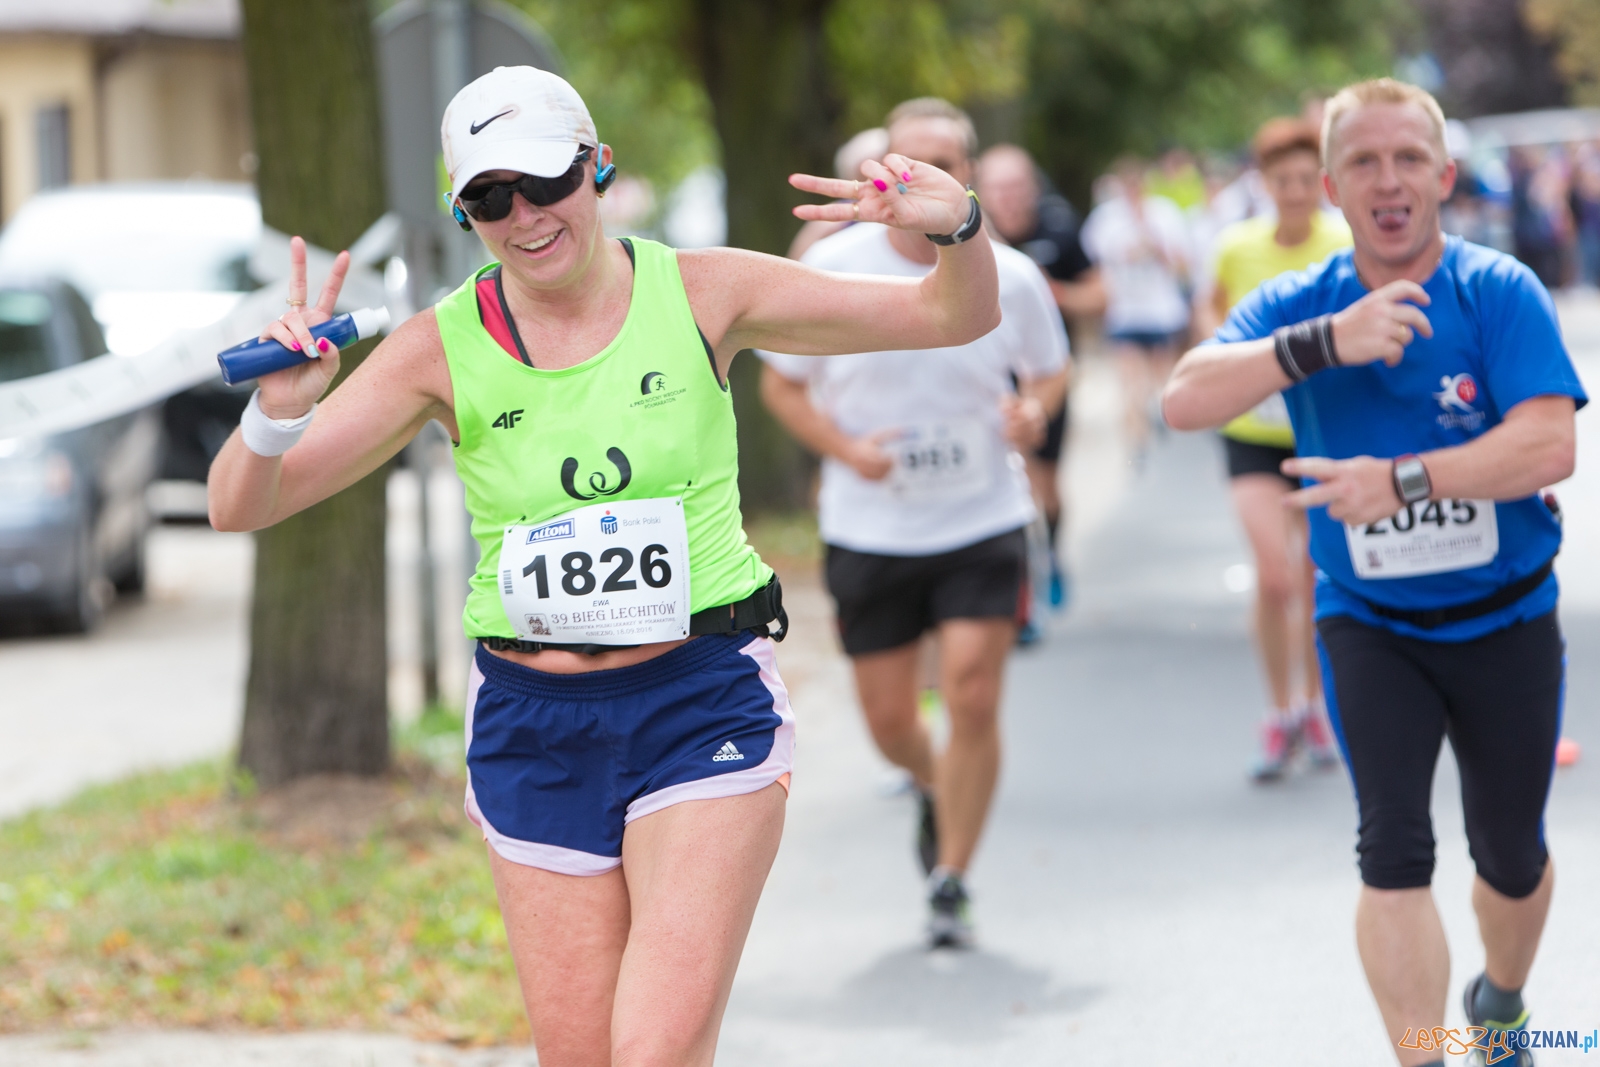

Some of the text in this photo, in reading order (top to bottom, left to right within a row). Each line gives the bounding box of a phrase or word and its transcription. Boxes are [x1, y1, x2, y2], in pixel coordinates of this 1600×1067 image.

[491, 408, 525, 430] 4F
[623, 518, 641, 527] Bank
[642, 515, 662, 525] Polski
[522, 543, 672, 599] 1826
[592, 599, 610, 607] EWA
[551, 600, 677, 625] 39 BIEG LECHITÓW
[712, 753, 745, 762] adidas
